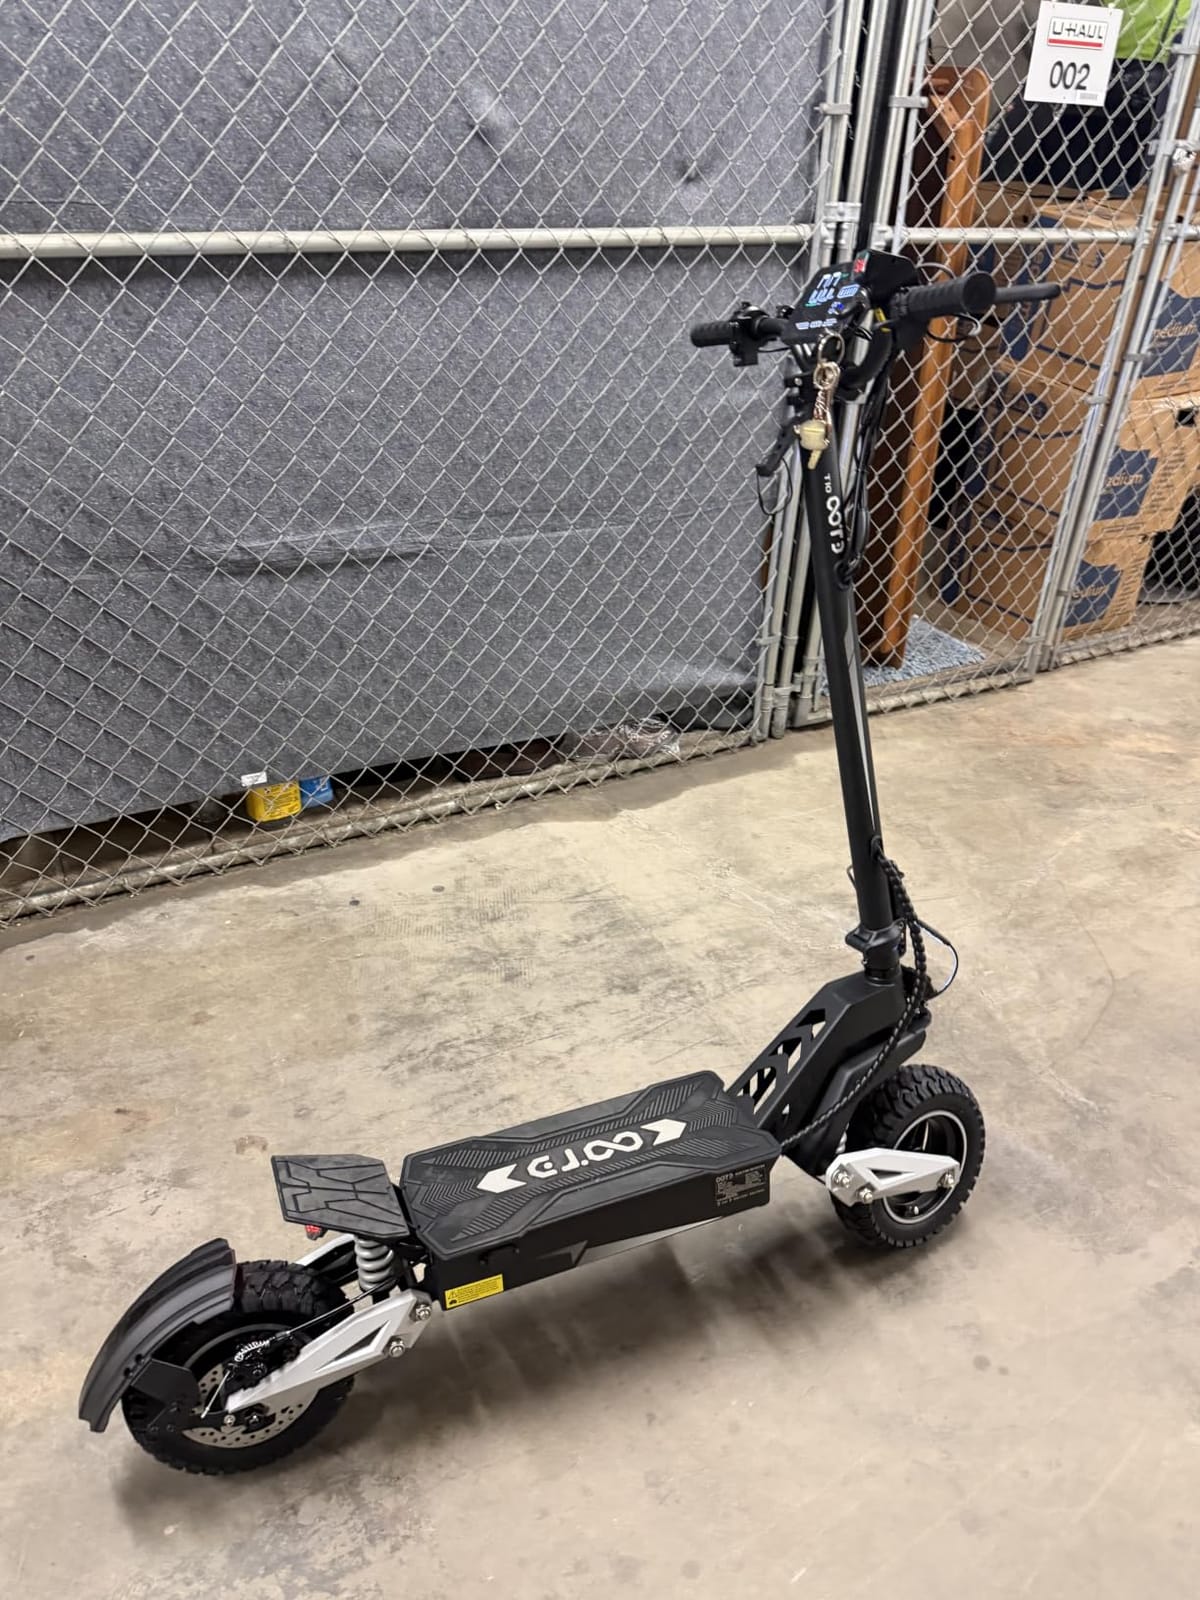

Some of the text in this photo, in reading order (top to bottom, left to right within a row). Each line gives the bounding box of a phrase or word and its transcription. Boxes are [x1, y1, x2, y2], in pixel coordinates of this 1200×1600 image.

[1052, 20, 1103, 39] U-HAUL
[1049, 60, 1090, 91] 002
[824, 473, 833, 493] T10
